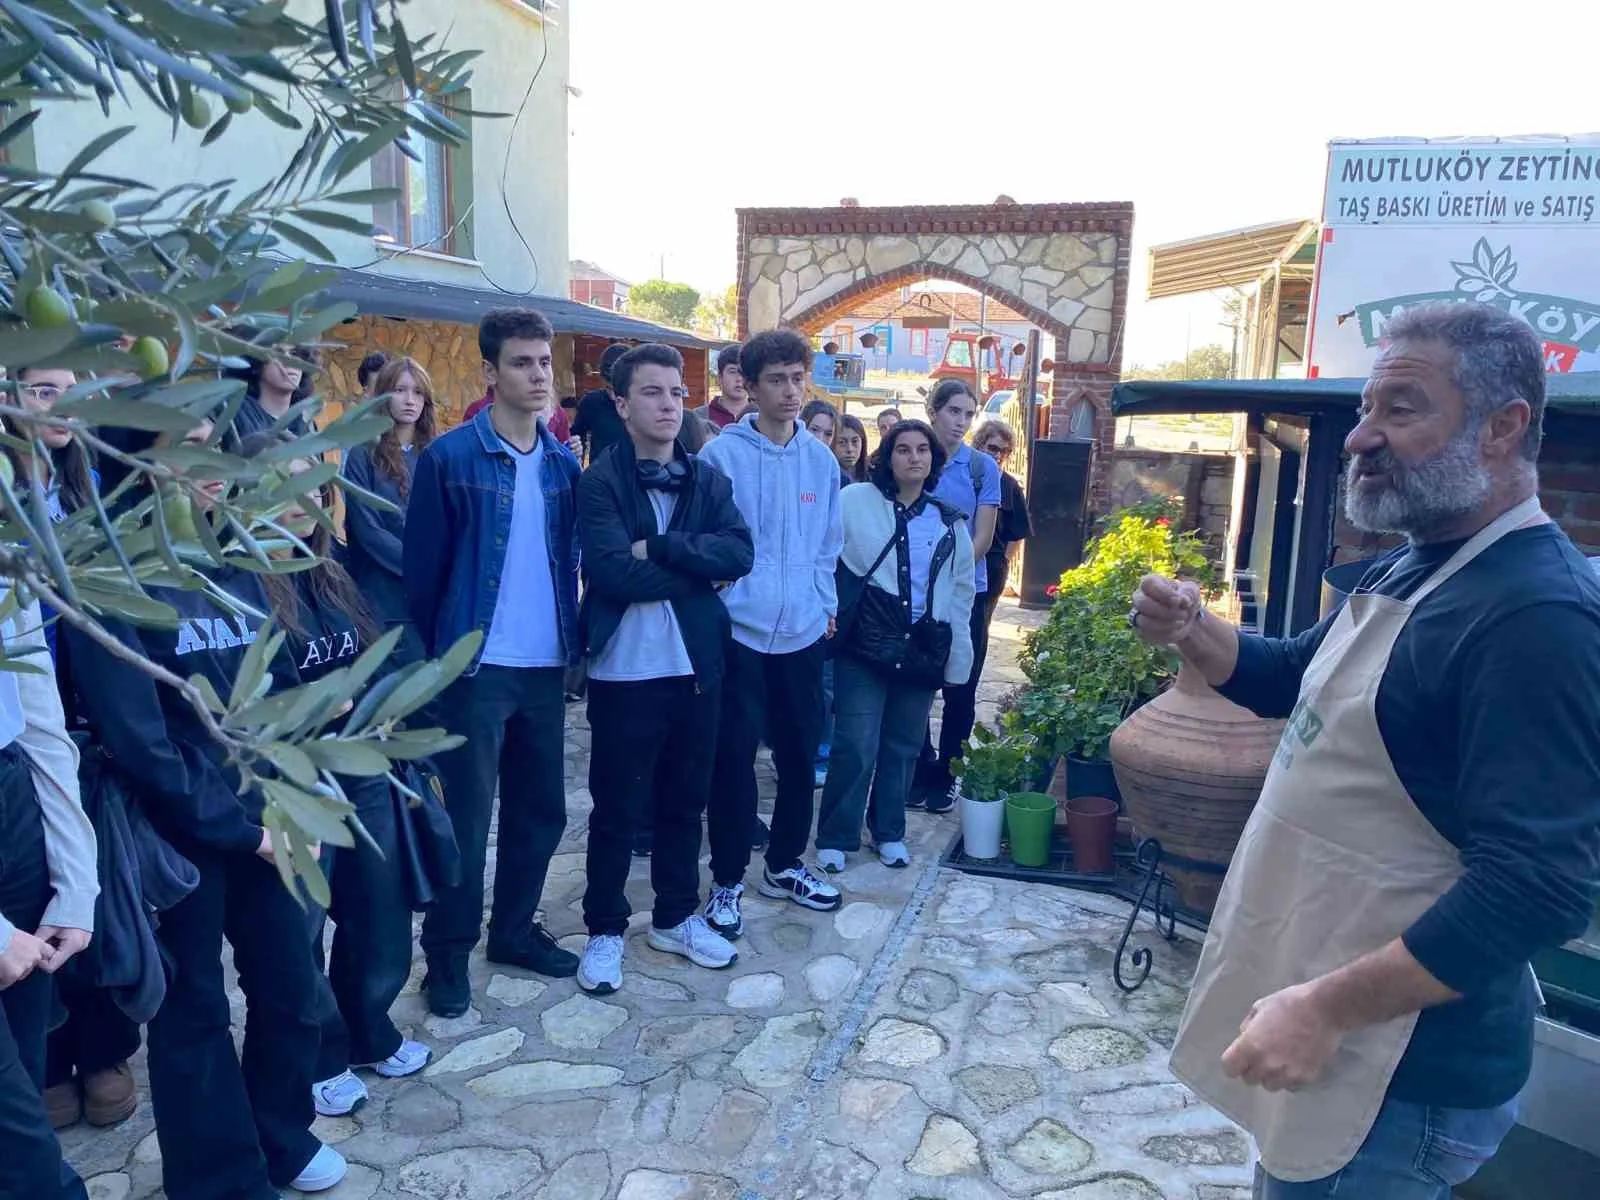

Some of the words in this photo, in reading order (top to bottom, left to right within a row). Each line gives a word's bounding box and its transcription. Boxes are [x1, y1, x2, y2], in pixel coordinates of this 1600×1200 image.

[1341, 150, 1491, 182] MUTLUKÖY
[1338, 196, 1370, 221] TAŞ
[1377, 196, 1430, 217] BASKI
[1437, 190, 1506, 217] ÜRETİM
[1514, 200, 1535, 217] ve
[1541, 195, 1595, 221] SATIŞ
